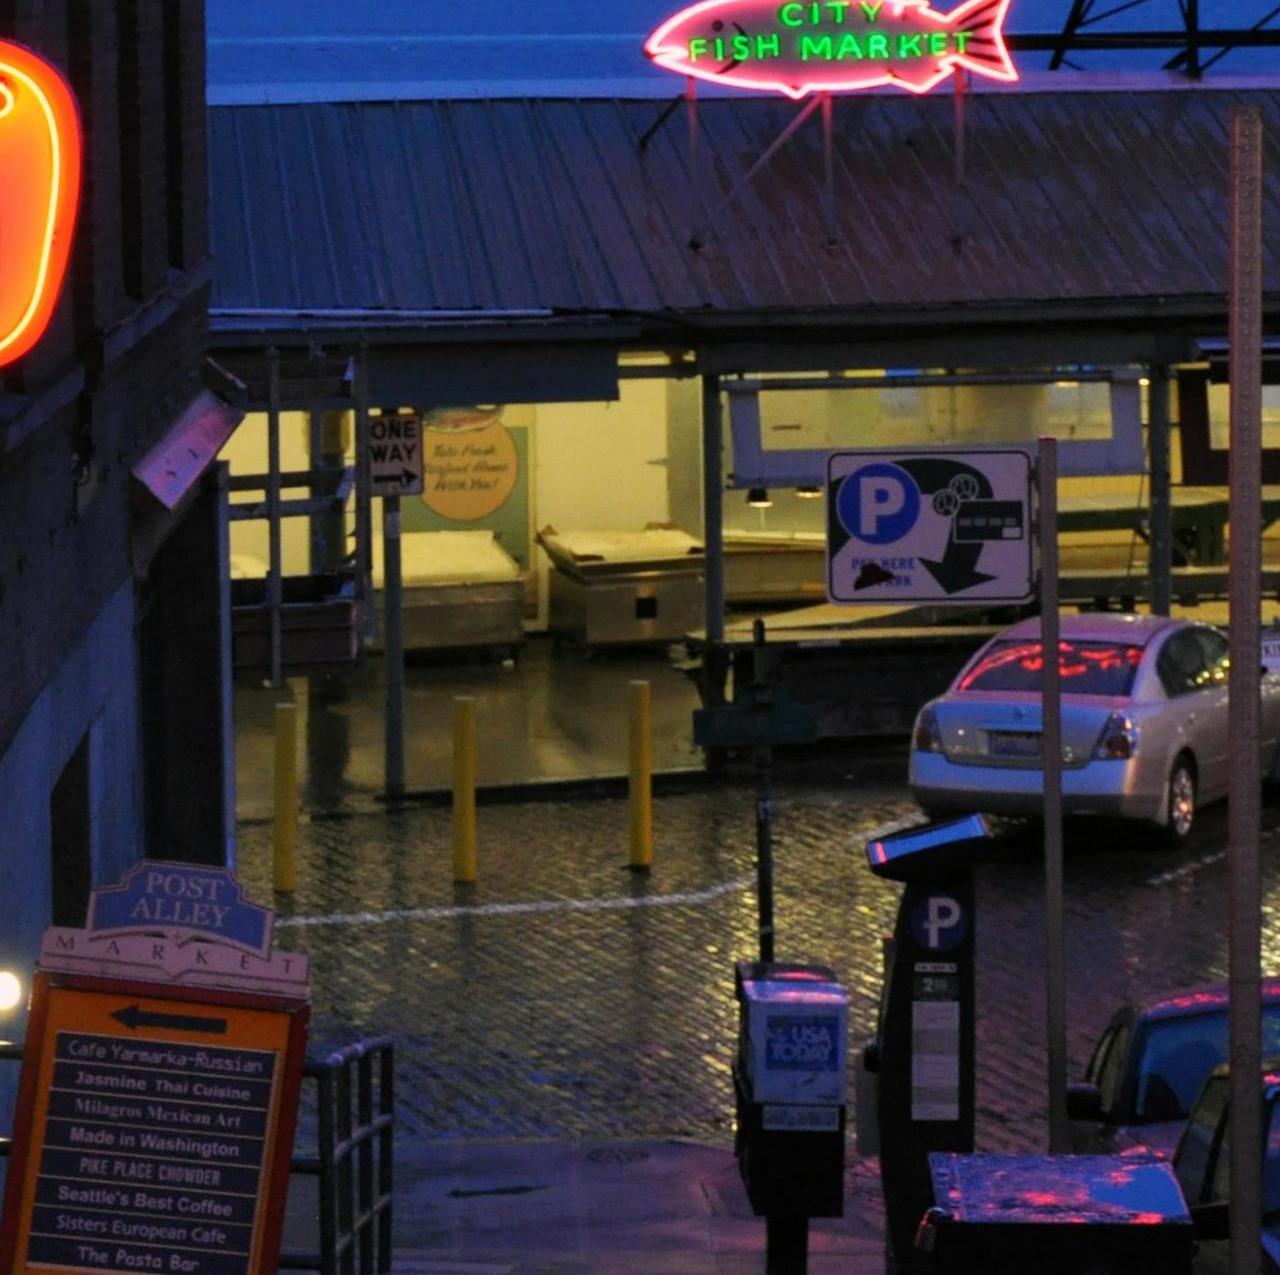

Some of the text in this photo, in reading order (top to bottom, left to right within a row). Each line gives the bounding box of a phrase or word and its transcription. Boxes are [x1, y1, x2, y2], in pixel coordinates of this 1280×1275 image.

[778, 0, 886, 29] CITY
[688, 30, 973, 63] FISH MARKET
[371, 420, 416, 439] ONE
[371, 445, 416, 463] WAY
[860, 476, 906, 536] P
[145, 872, 226, 900] POST
[130, 897, 232, 927] ALLEY
[924, 896, 961, 948] P
[55, 934, 296, 974] MARKET
[792, 1026, 830, 1043] USA
[68, 1040, 107, 1059] Cafe
[771, 1039, 833, 1062] TODAY
[75, 1070, 251, 1101] Jasmine Thai Cuisine
[75, 1098, 241, 1128] Milagros Mexican Art
[69, 1126, 240, 1158] Made in Washington
[79, 1157, 221, 1186] PIKE PLACE CHOWDER
[57, 1185, 233, 1217] Seattle's Best Coffee
[56, 1215, 227, 1244] Sisters European Cafe
[78, 1246, 200, 1272] The Pasta Bar
